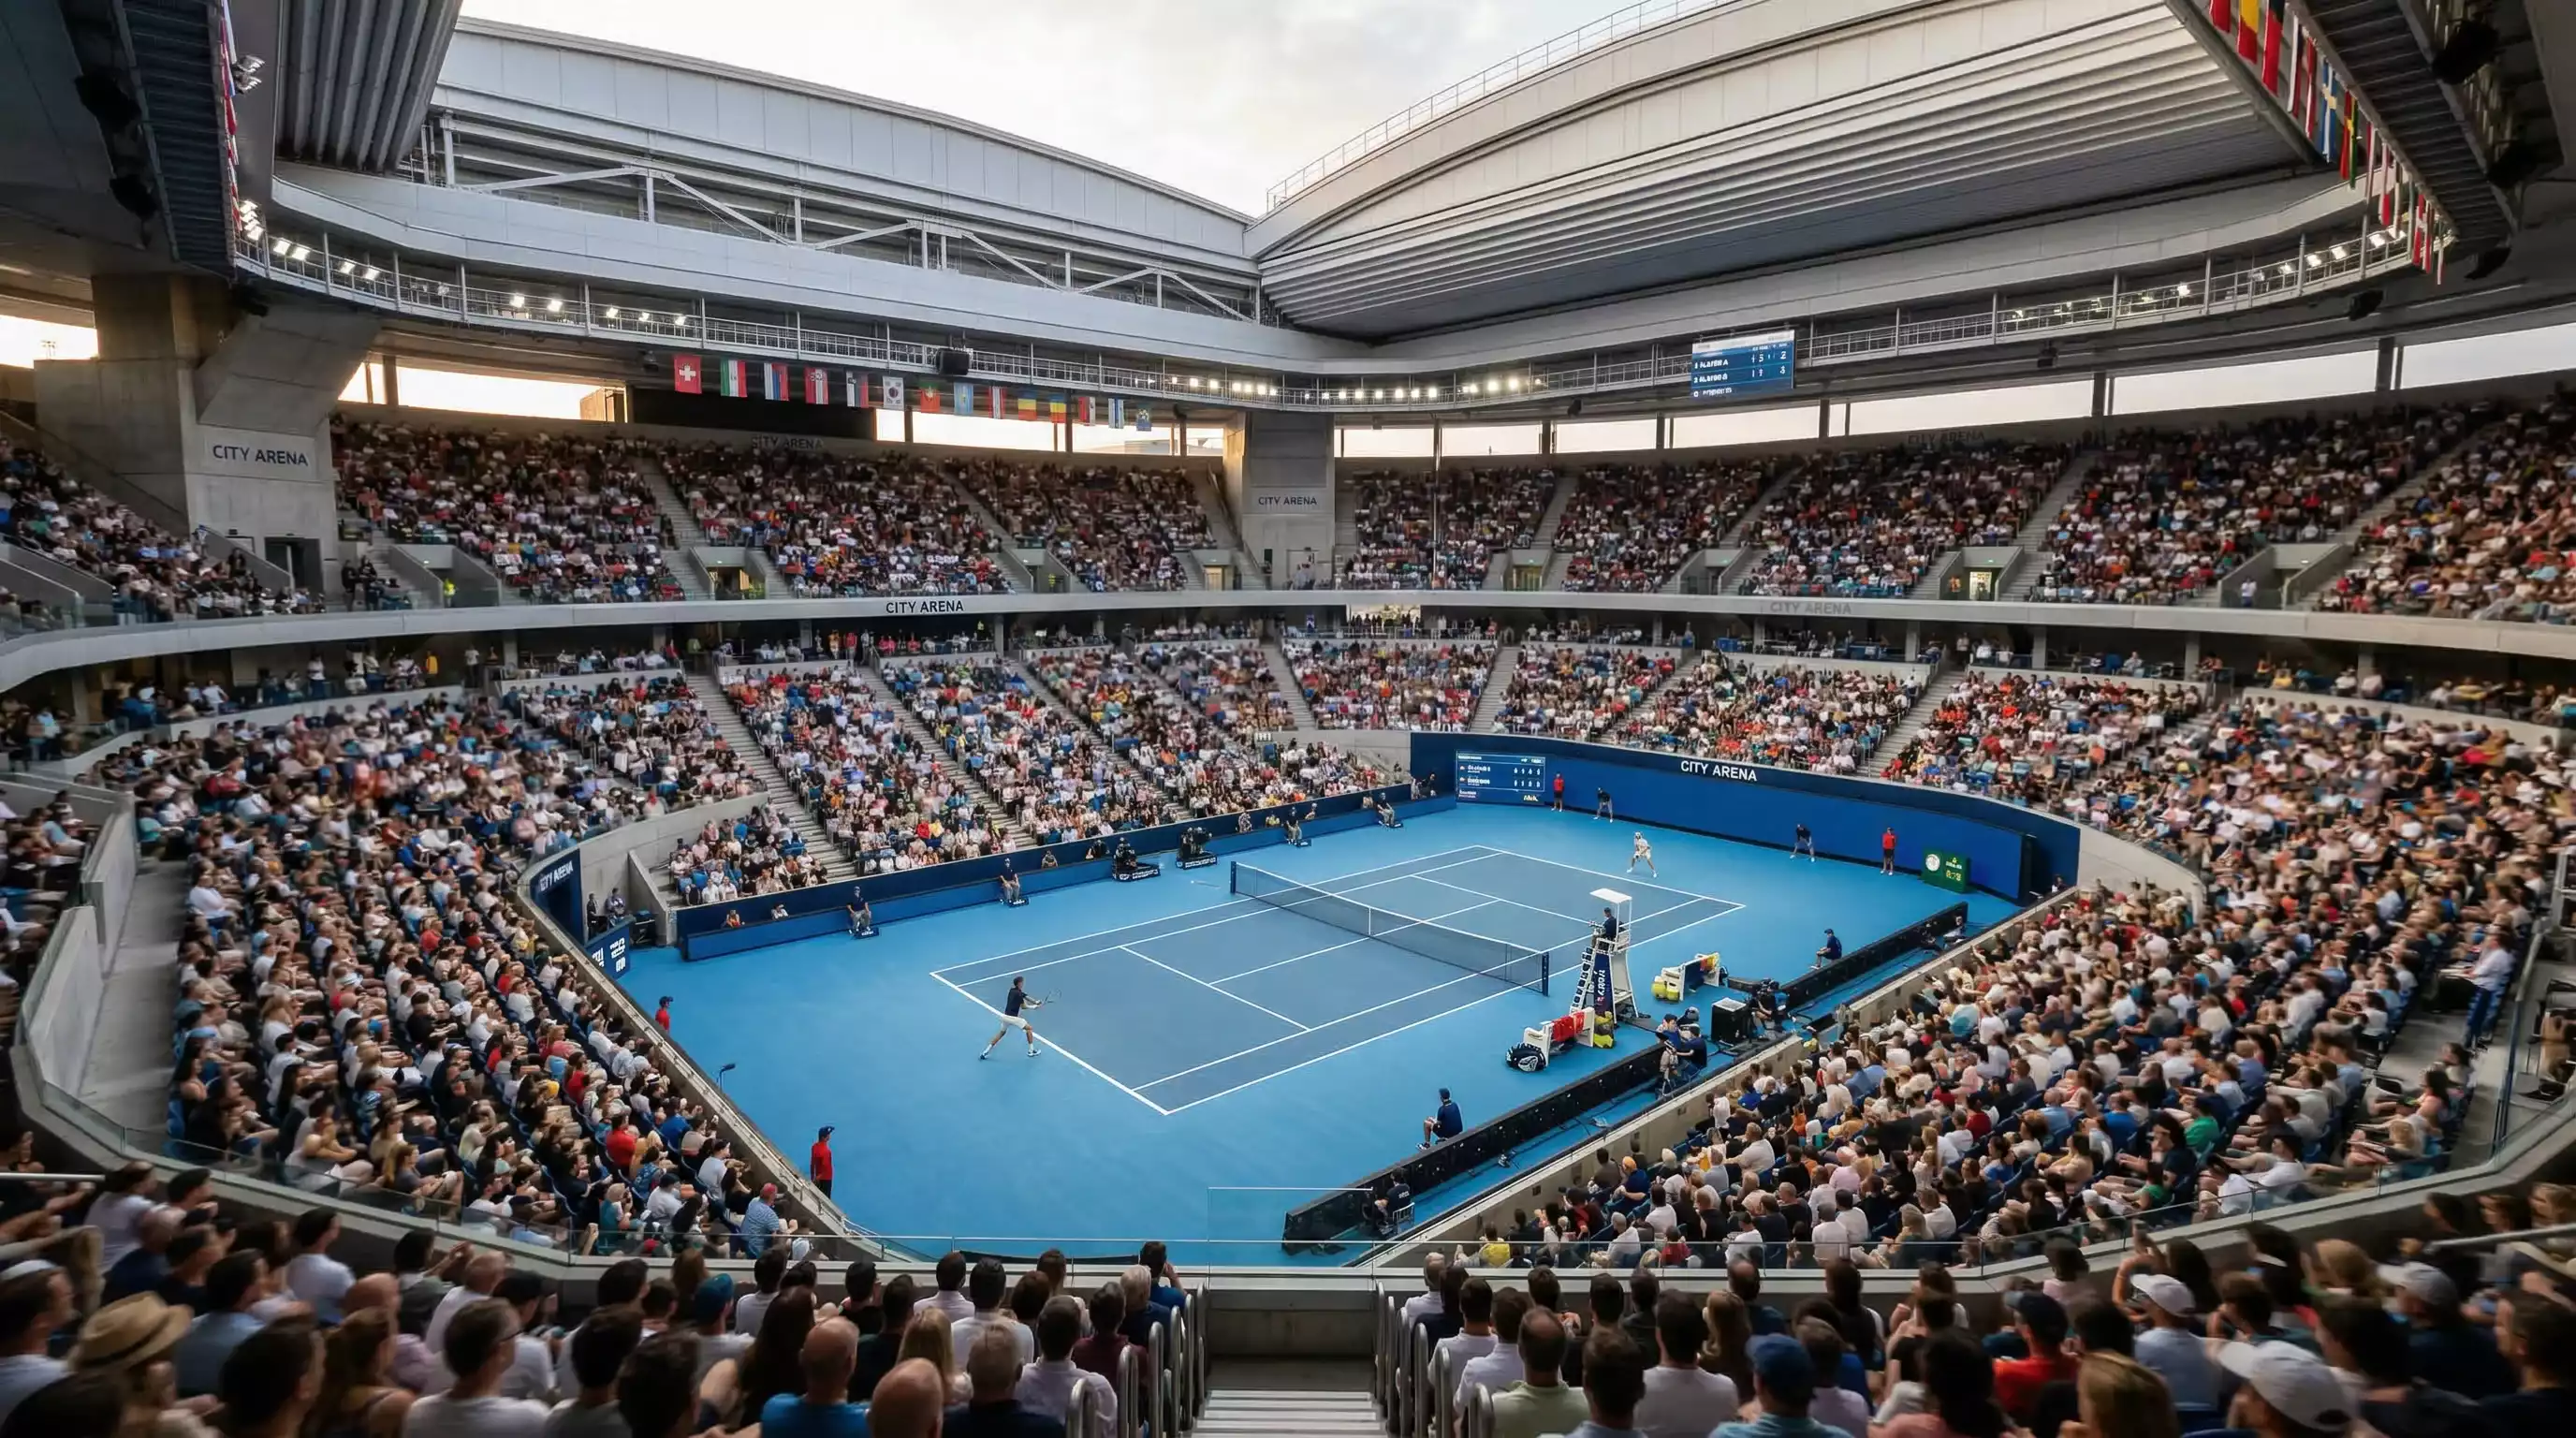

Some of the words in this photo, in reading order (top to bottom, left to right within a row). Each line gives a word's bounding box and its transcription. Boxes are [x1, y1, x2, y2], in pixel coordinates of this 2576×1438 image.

[212, 445, 250, 462] CITY
[255, 449, 308, 466] ARENA
[1258, 496, 1281, 506] CITY
[1283, 496, 1317, 506] ARENA
[886, 601, 916, 613] CITY
[920, 600, 964, 612] ARENA
[1770, 602, 1800, 613] CITY
[1805, 602, 1852, 615] ARENA
[1680, 760, 1708, 774] CITY
[1712, 765, 1757, 782] ARENA
